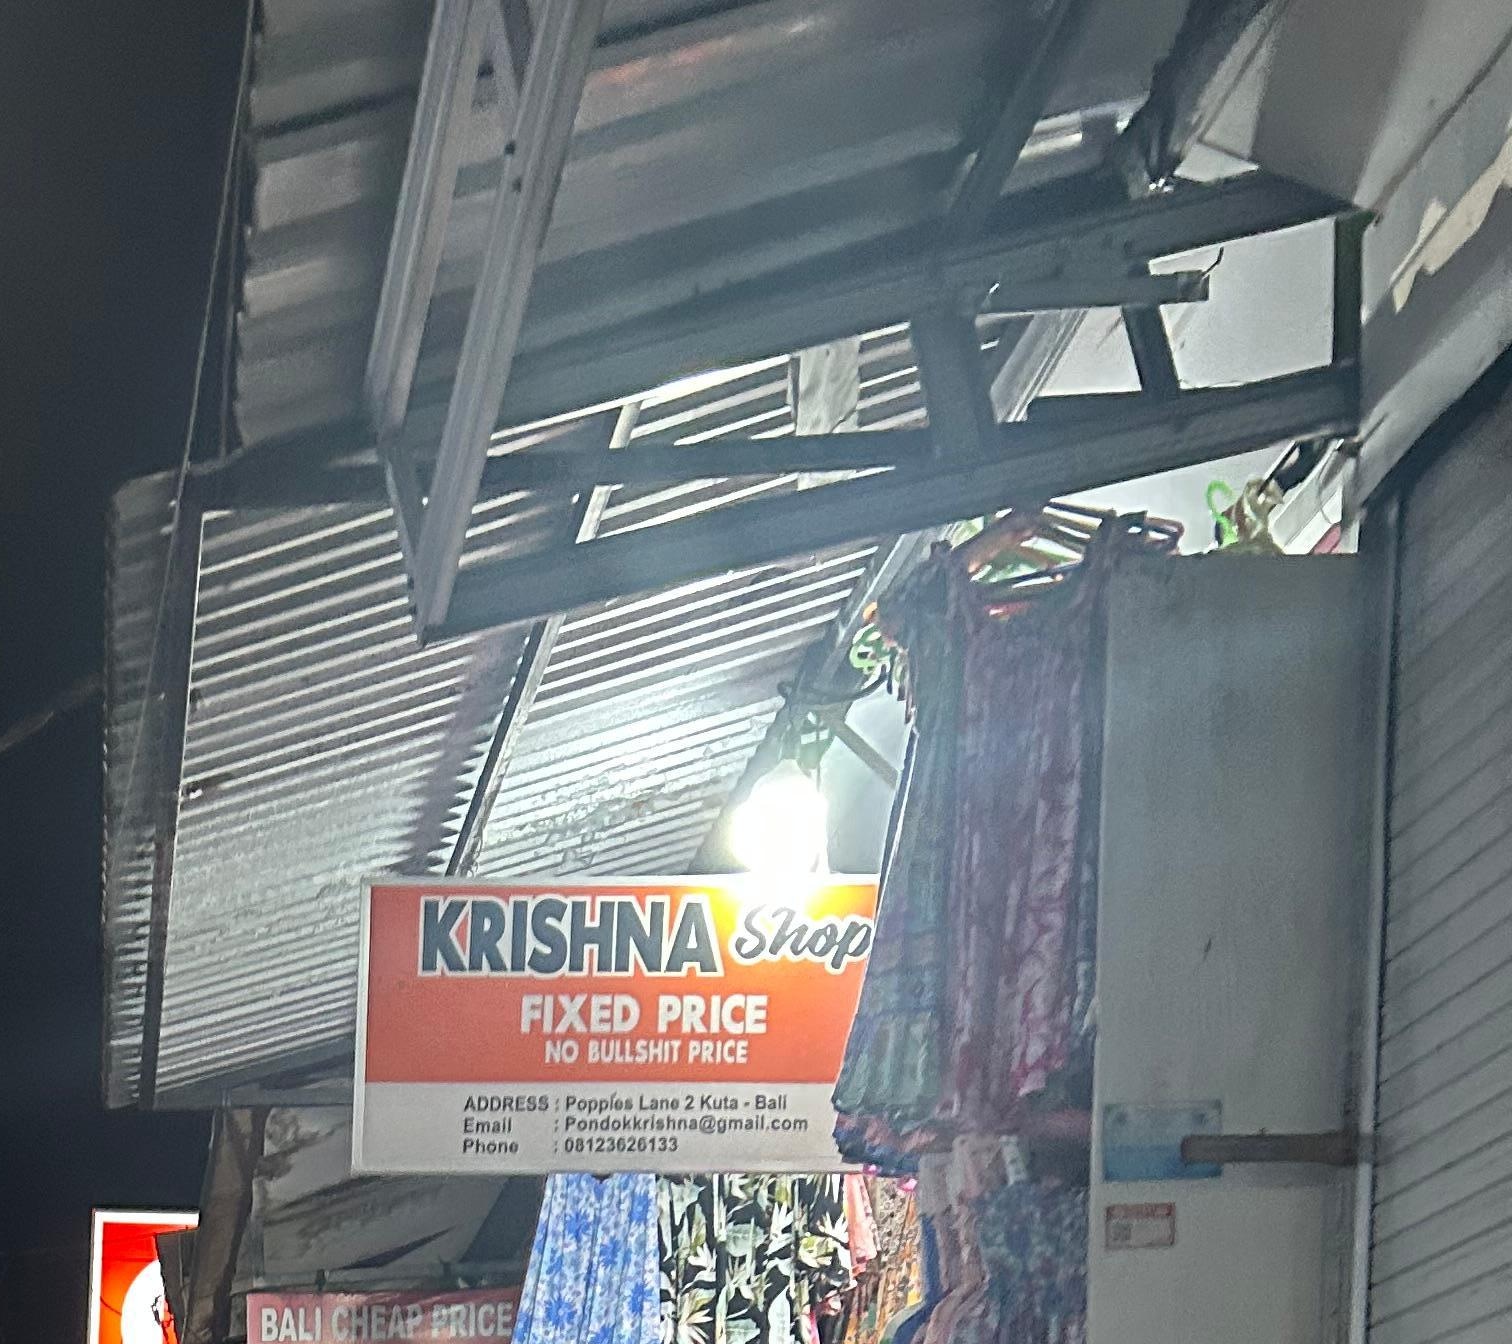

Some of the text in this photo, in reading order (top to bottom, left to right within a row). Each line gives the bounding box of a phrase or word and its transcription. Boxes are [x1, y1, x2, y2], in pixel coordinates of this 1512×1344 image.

[421, 896, 873, 975] KRISHNA Shop
[519, 993, 768, 1035] FIXED PRICE
[545, 1039, 749, 1065] NO BULLSHIT PRICE
[463, 1094, 550, 1113] ADDRESS
[565, 1093, 634, 1115] Poppies
[639, 1094, 680, 1111] Lane
[684, 1095, 695, 1111] 2
[700, 1094, 739, 1111] Kuta
[755, 1094, 788, 1111] Bali
[463, 1116, 513, 1134] Email
[565, 1114, 808, 1134] Pondokkrishna@gmail.com
[462, 1137, 520, 1154] Phone
[261, 1301, 513, 1342] BALI CHEAP PRICE
